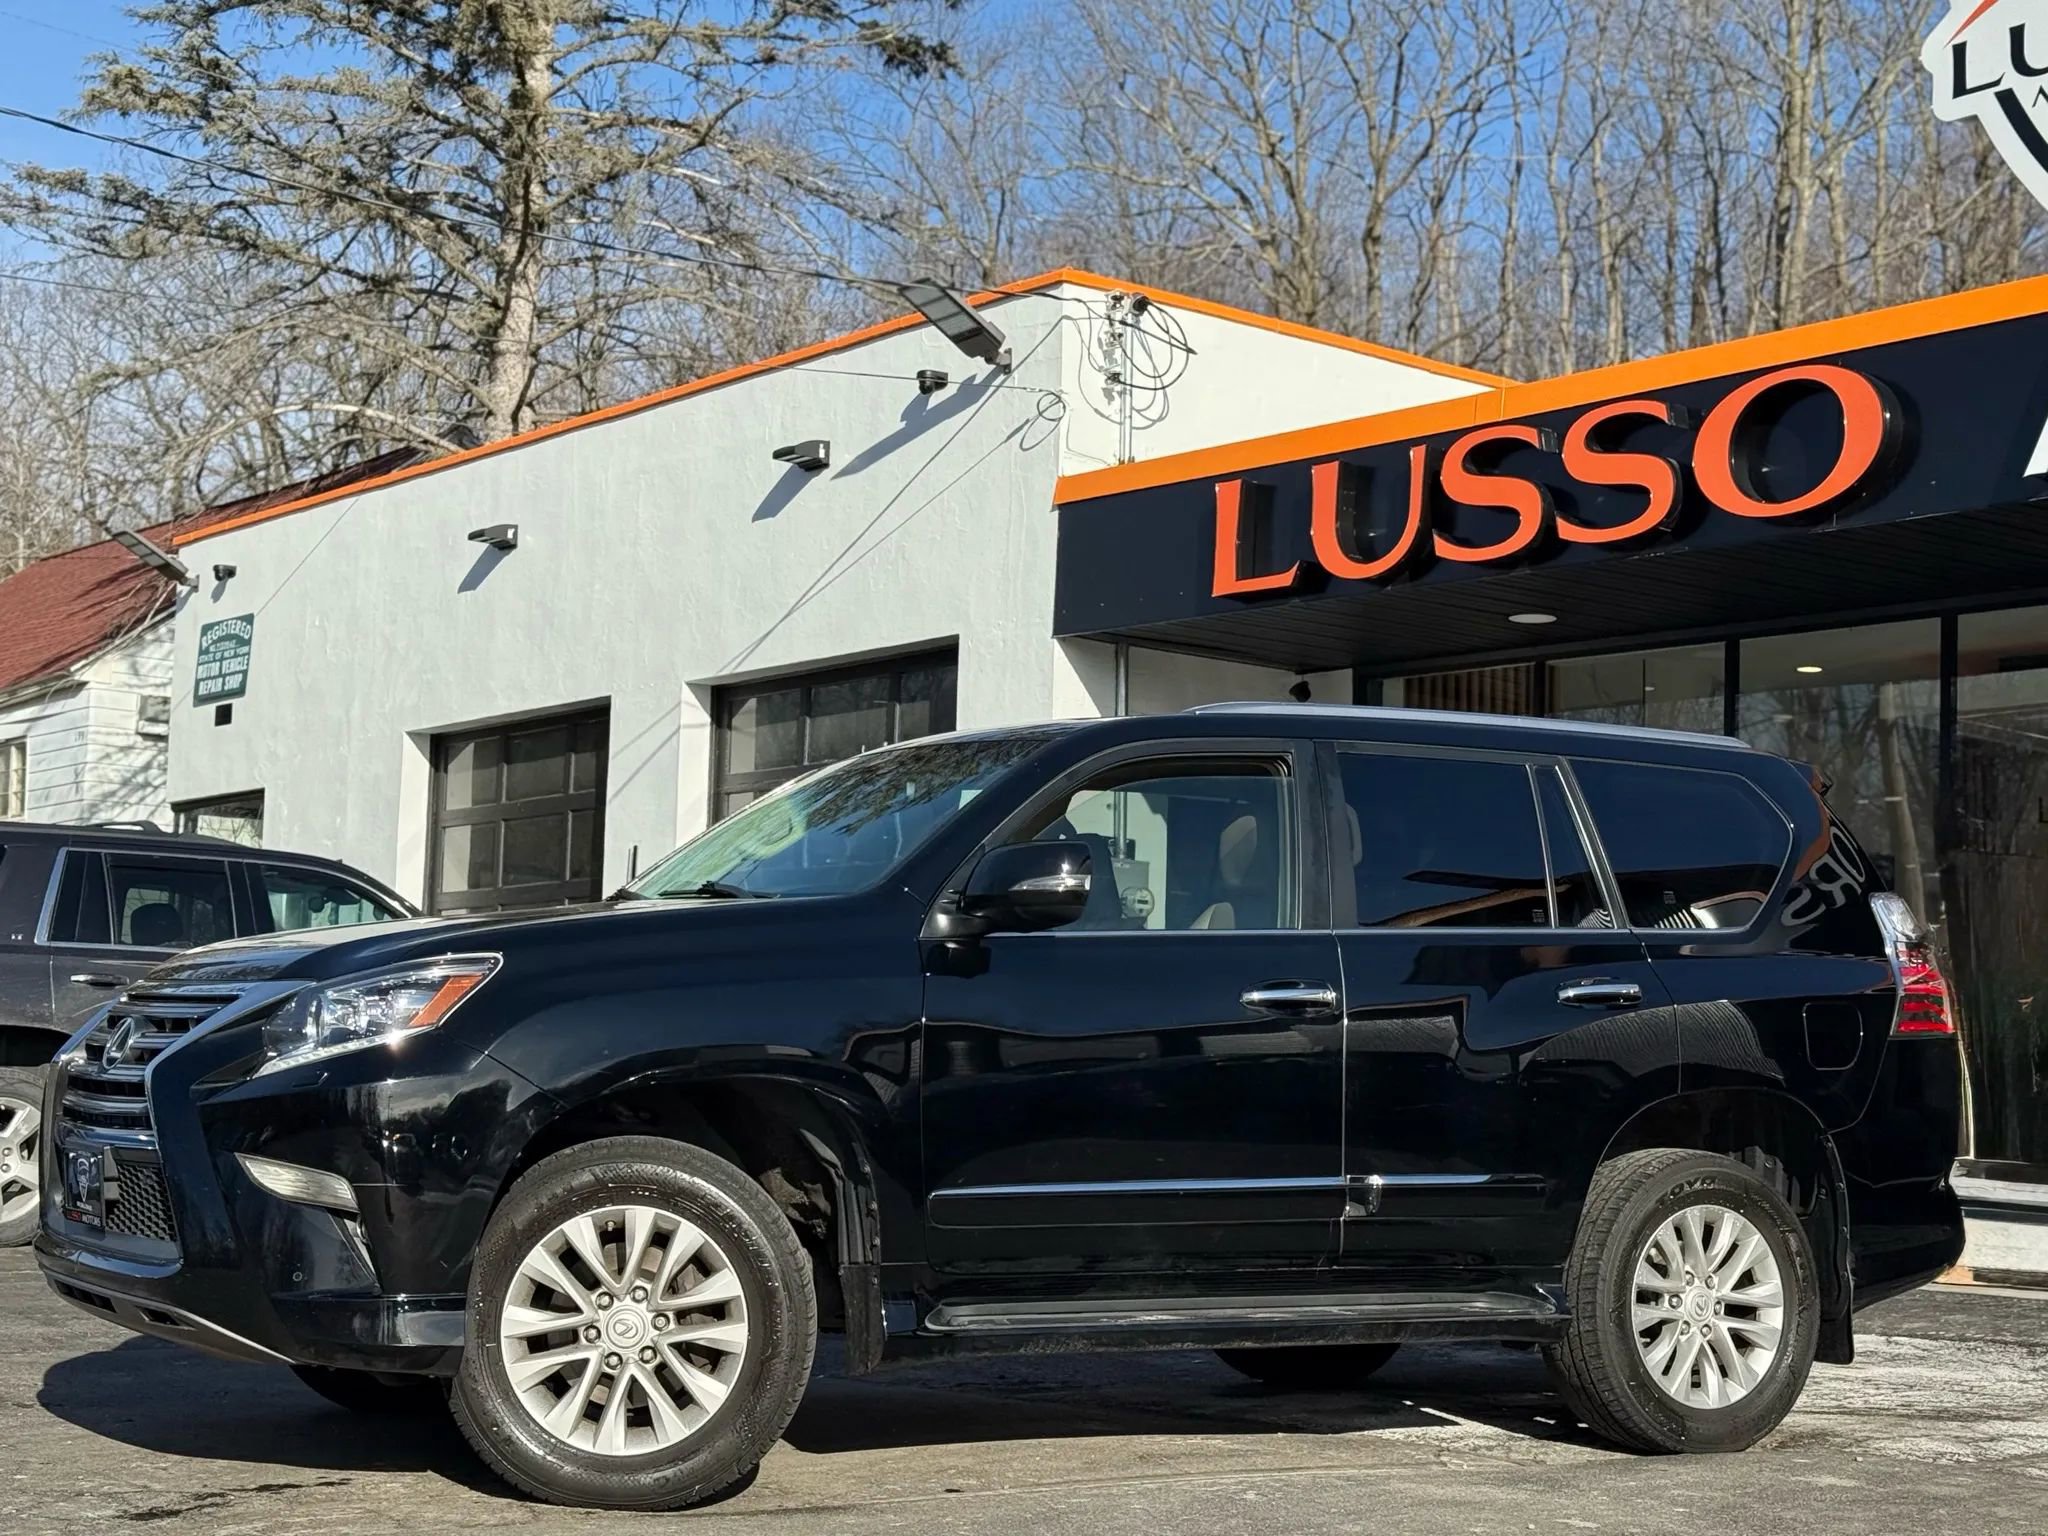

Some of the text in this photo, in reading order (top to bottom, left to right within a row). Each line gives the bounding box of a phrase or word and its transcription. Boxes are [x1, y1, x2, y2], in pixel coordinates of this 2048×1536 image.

[1212, 364, 1891, 598] LUSSO
[201, 619, 252, 651] REGISTERED
[197, 655, 248, 680] MOTOR VEHICLE
[198, 653, 214, 663] STATE
[215, 651, 222, 660] OF
[223, 648, 235, 658] NEW
[198, 673, 243, 696] REPAIR SHOP
